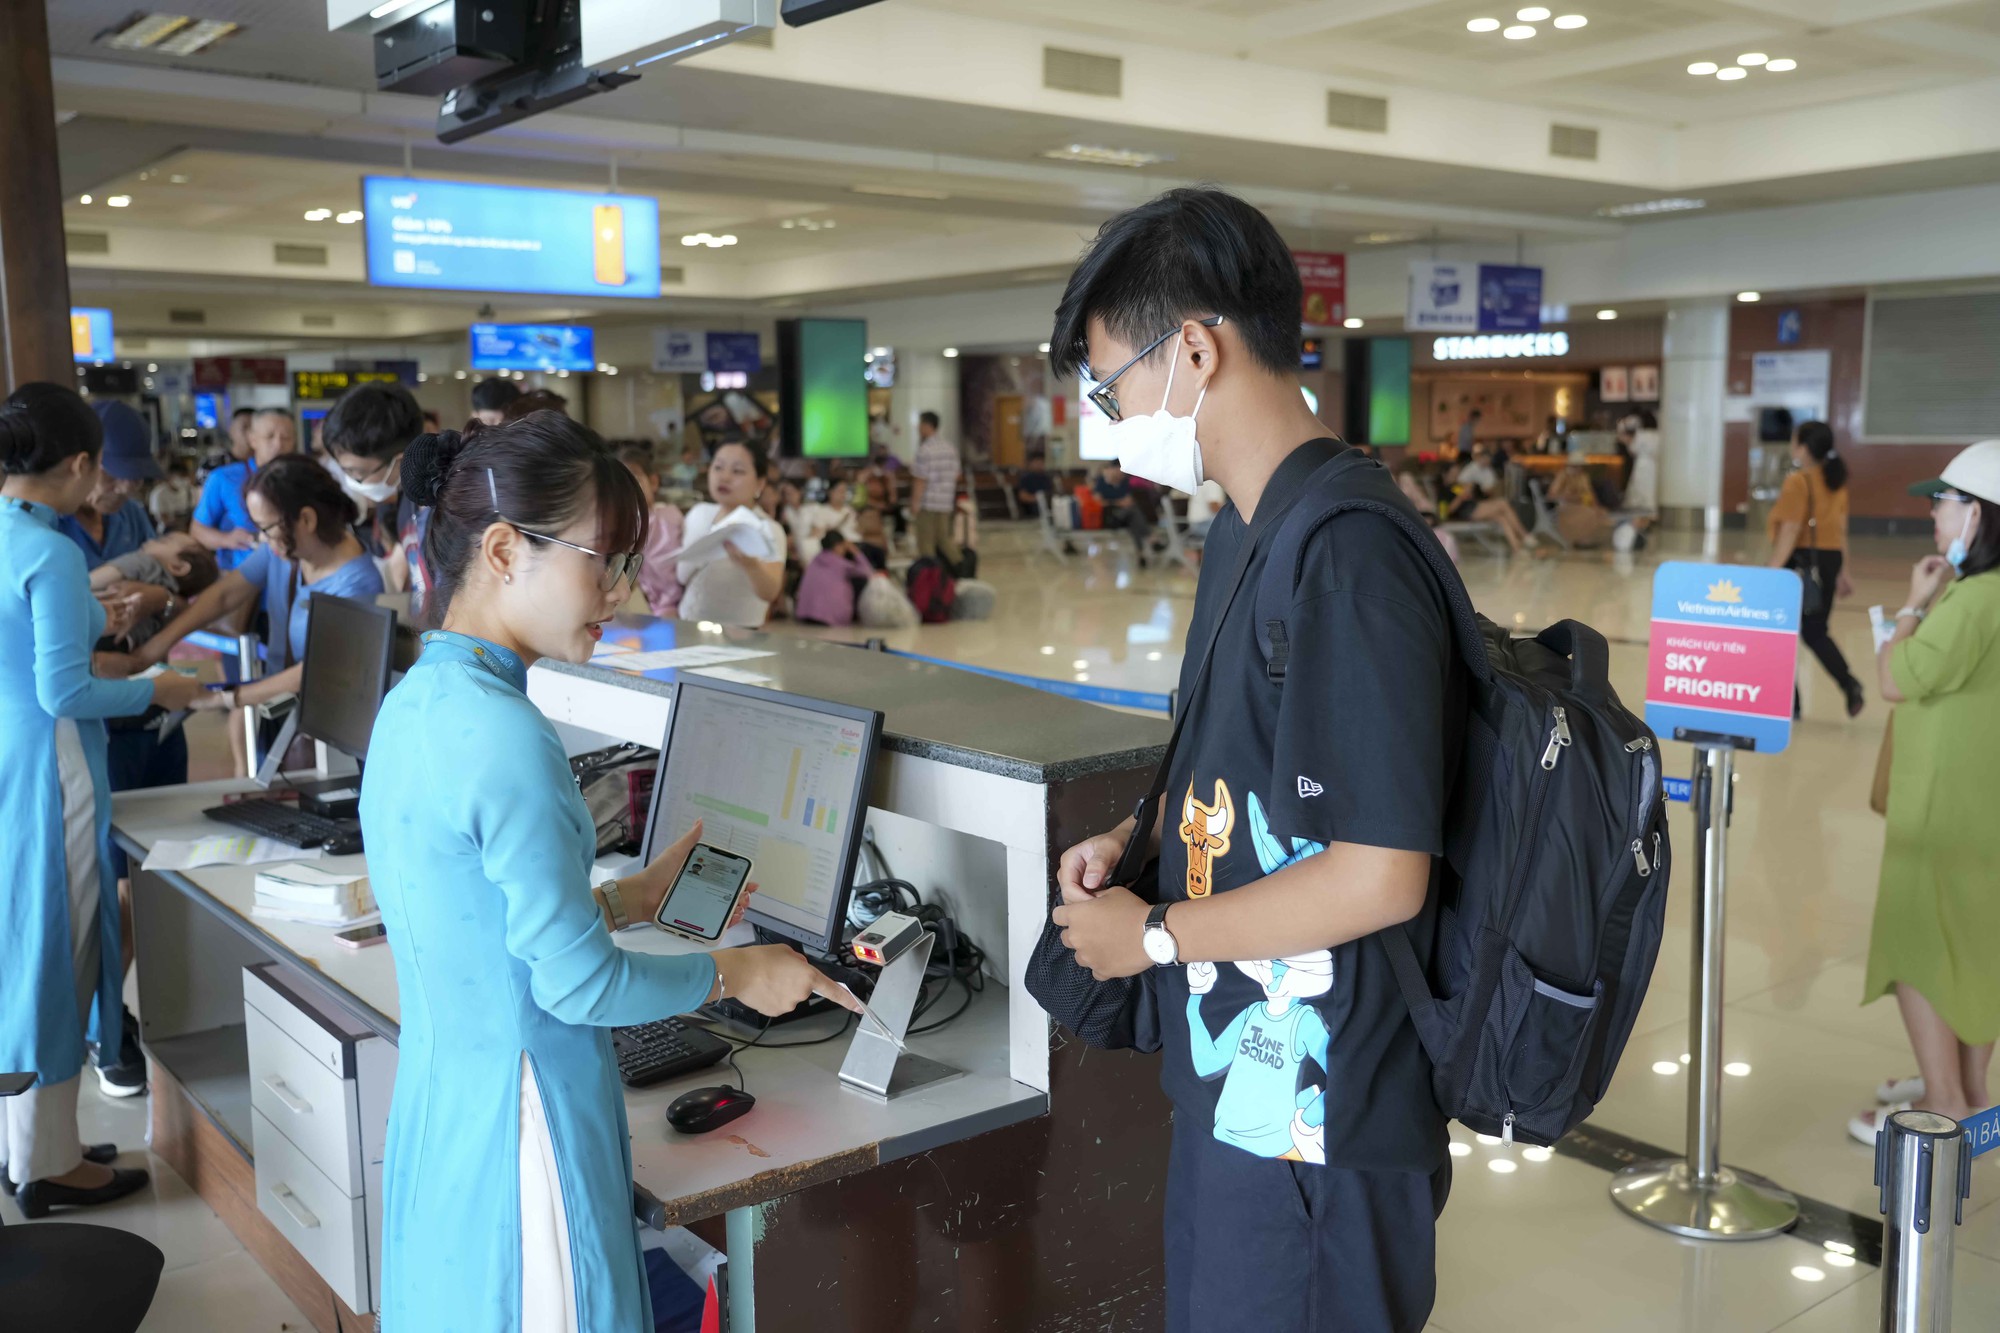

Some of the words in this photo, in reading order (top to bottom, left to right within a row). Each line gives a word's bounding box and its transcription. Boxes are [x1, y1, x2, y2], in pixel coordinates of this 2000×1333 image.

[1432, 331, 1569, 360] STARBUCKS
[1665, 653, 1707, 673] SKY
[1664, 675, 1761, 703] PRIORITY
[1239, 1038, 1284, 1070] SQUAD
[1250, 1025, 1284, 1056] TUNE
